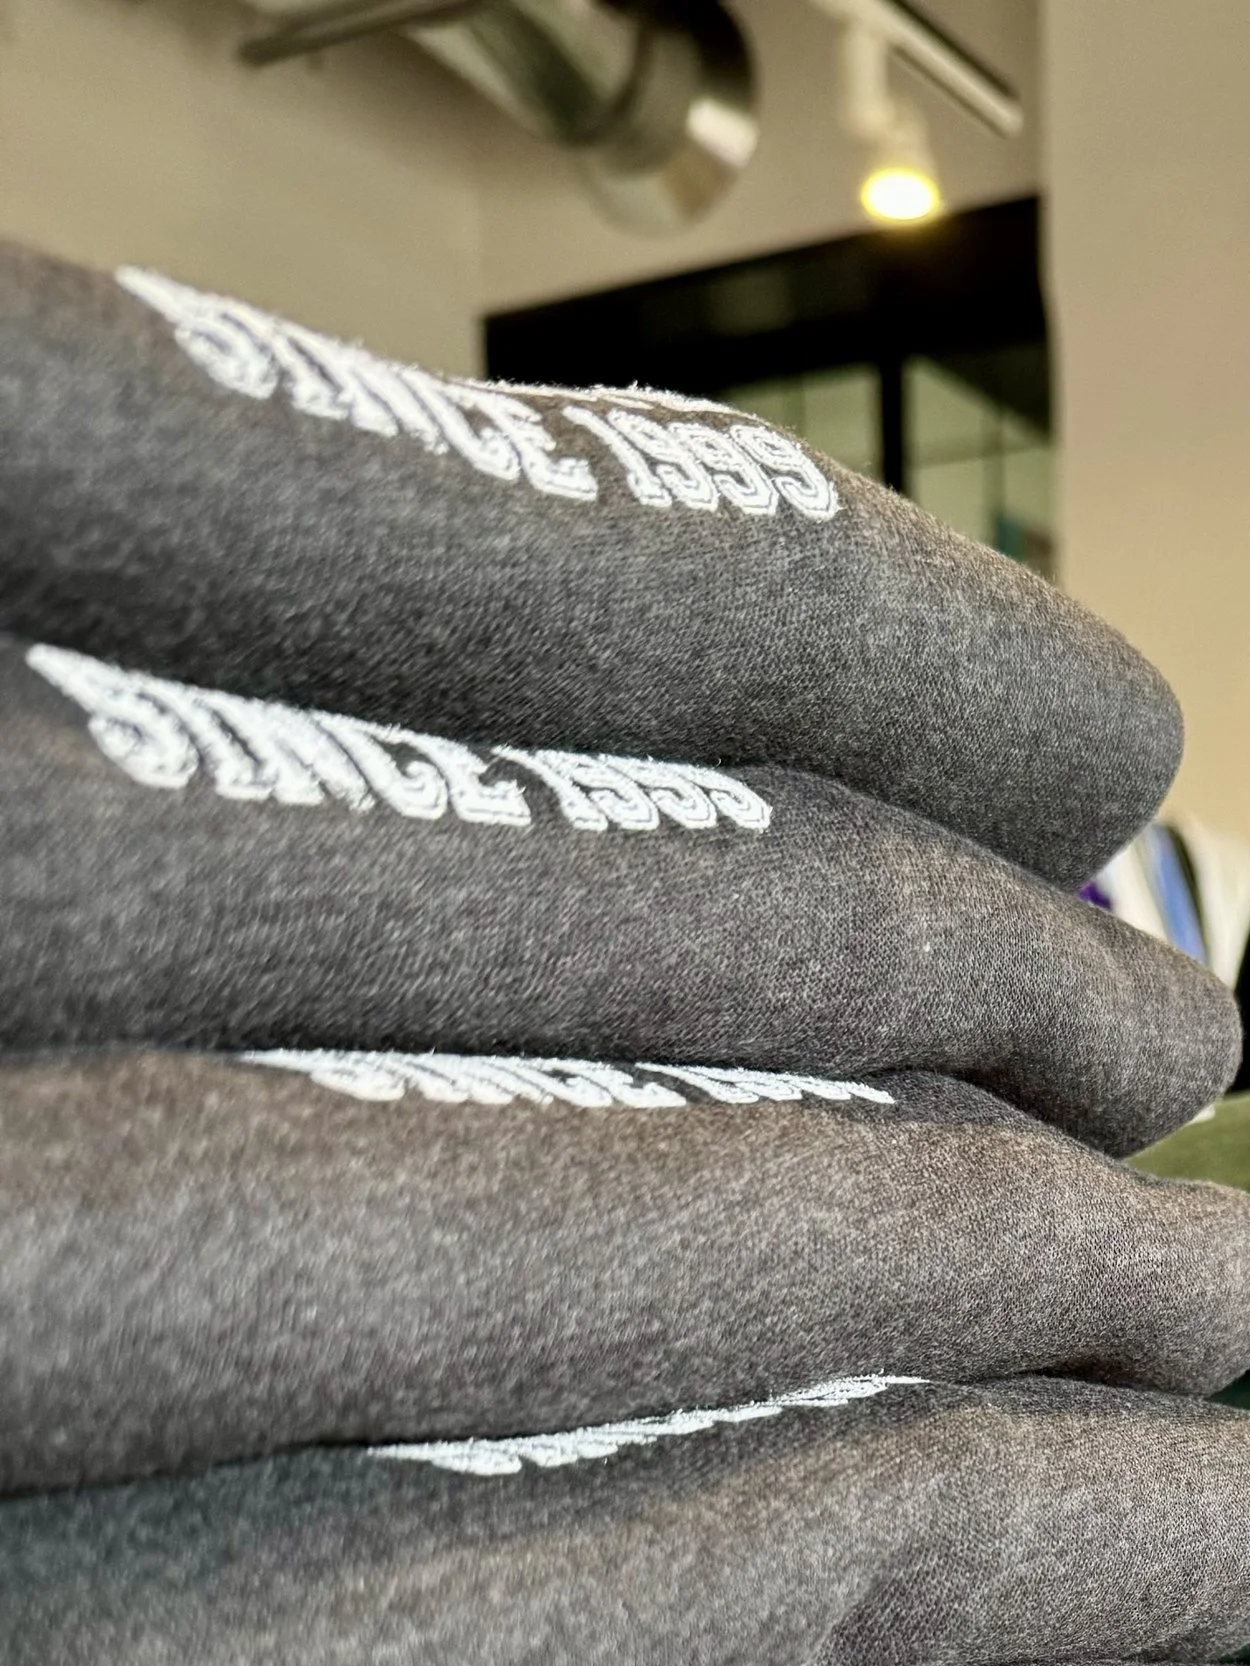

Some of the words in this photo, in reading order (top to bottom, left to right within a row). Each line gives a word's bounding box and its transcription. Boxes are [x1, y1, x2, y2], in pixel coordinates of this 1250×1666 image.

[115, 263, 598, 500] SINCE
[562, 405, 839, 521] 1999
[26, 643, 532, 826] SINCE
